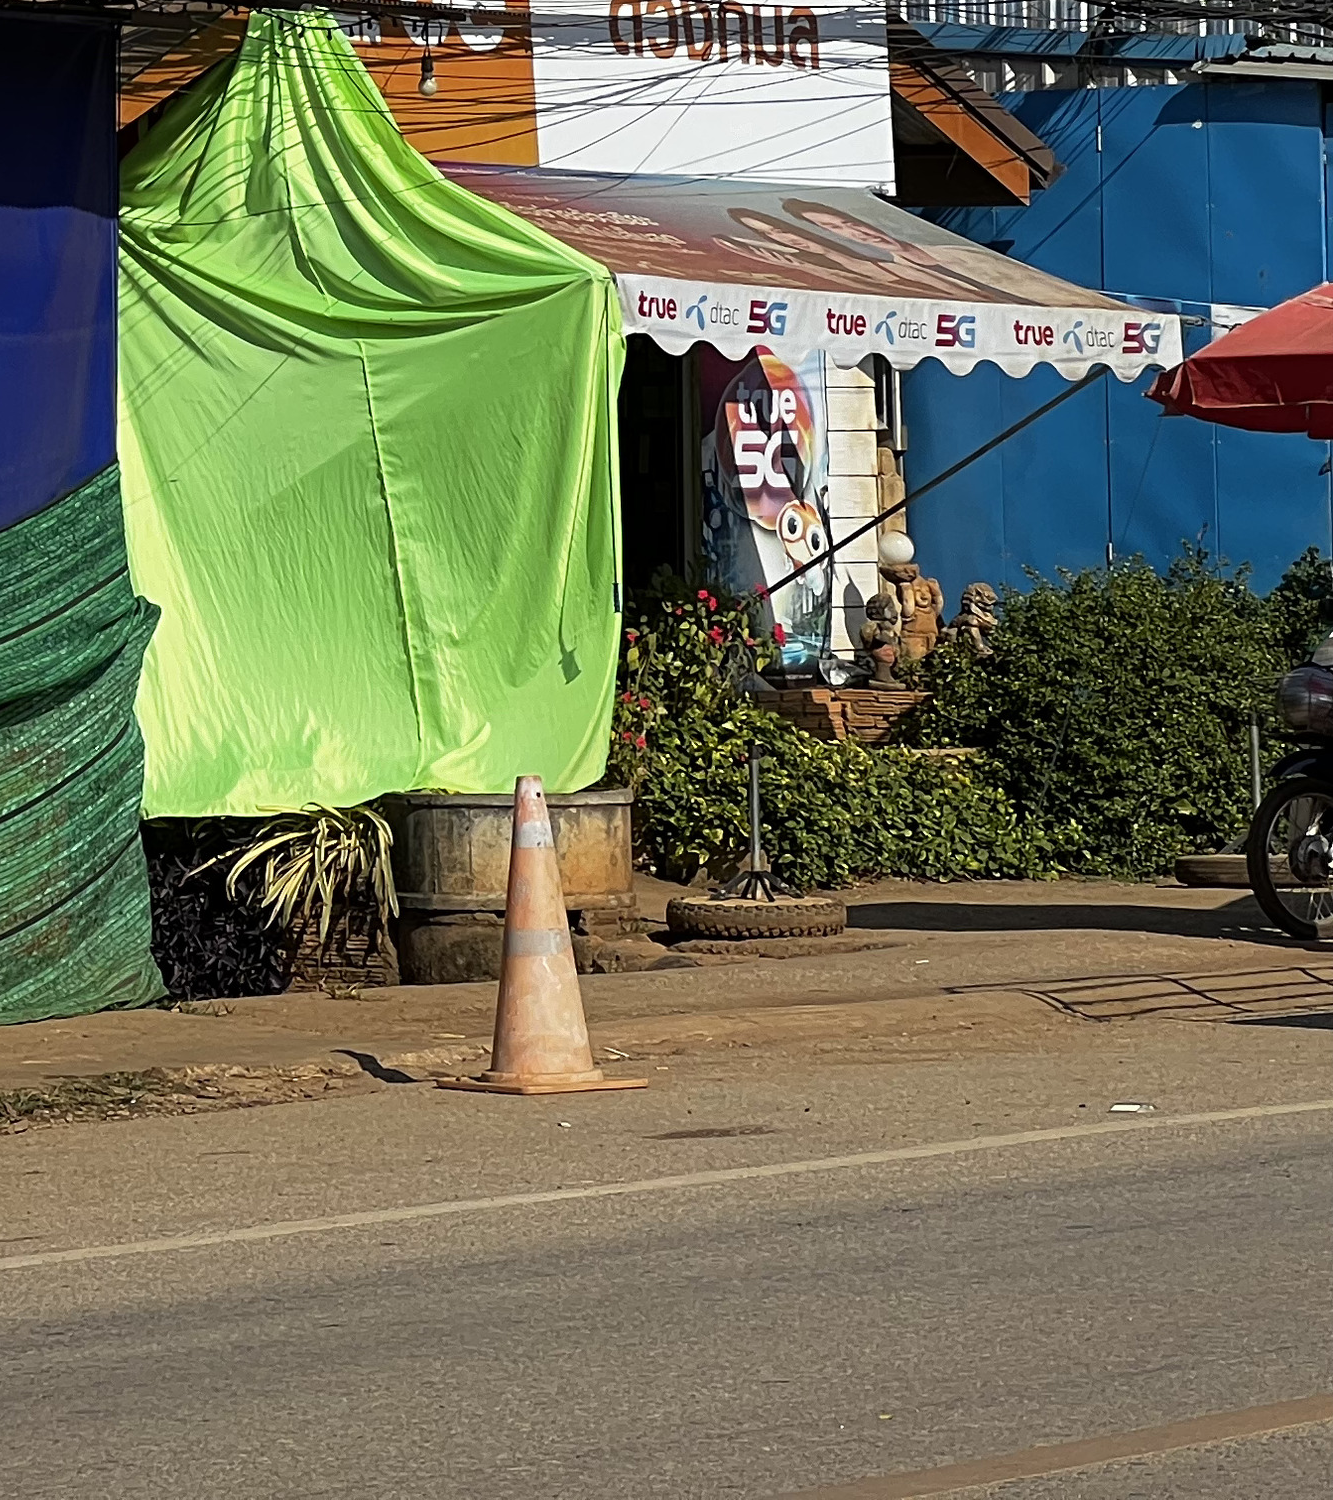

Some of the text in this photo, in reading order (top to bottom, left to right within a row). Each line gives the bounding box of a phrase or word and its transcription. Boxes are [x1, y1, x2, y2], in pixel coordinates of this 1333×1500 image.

[638, 290, 1161, 354] true dtac 5G true dtac 5G true dtac 5G
[736, 381, 797, 424] true
